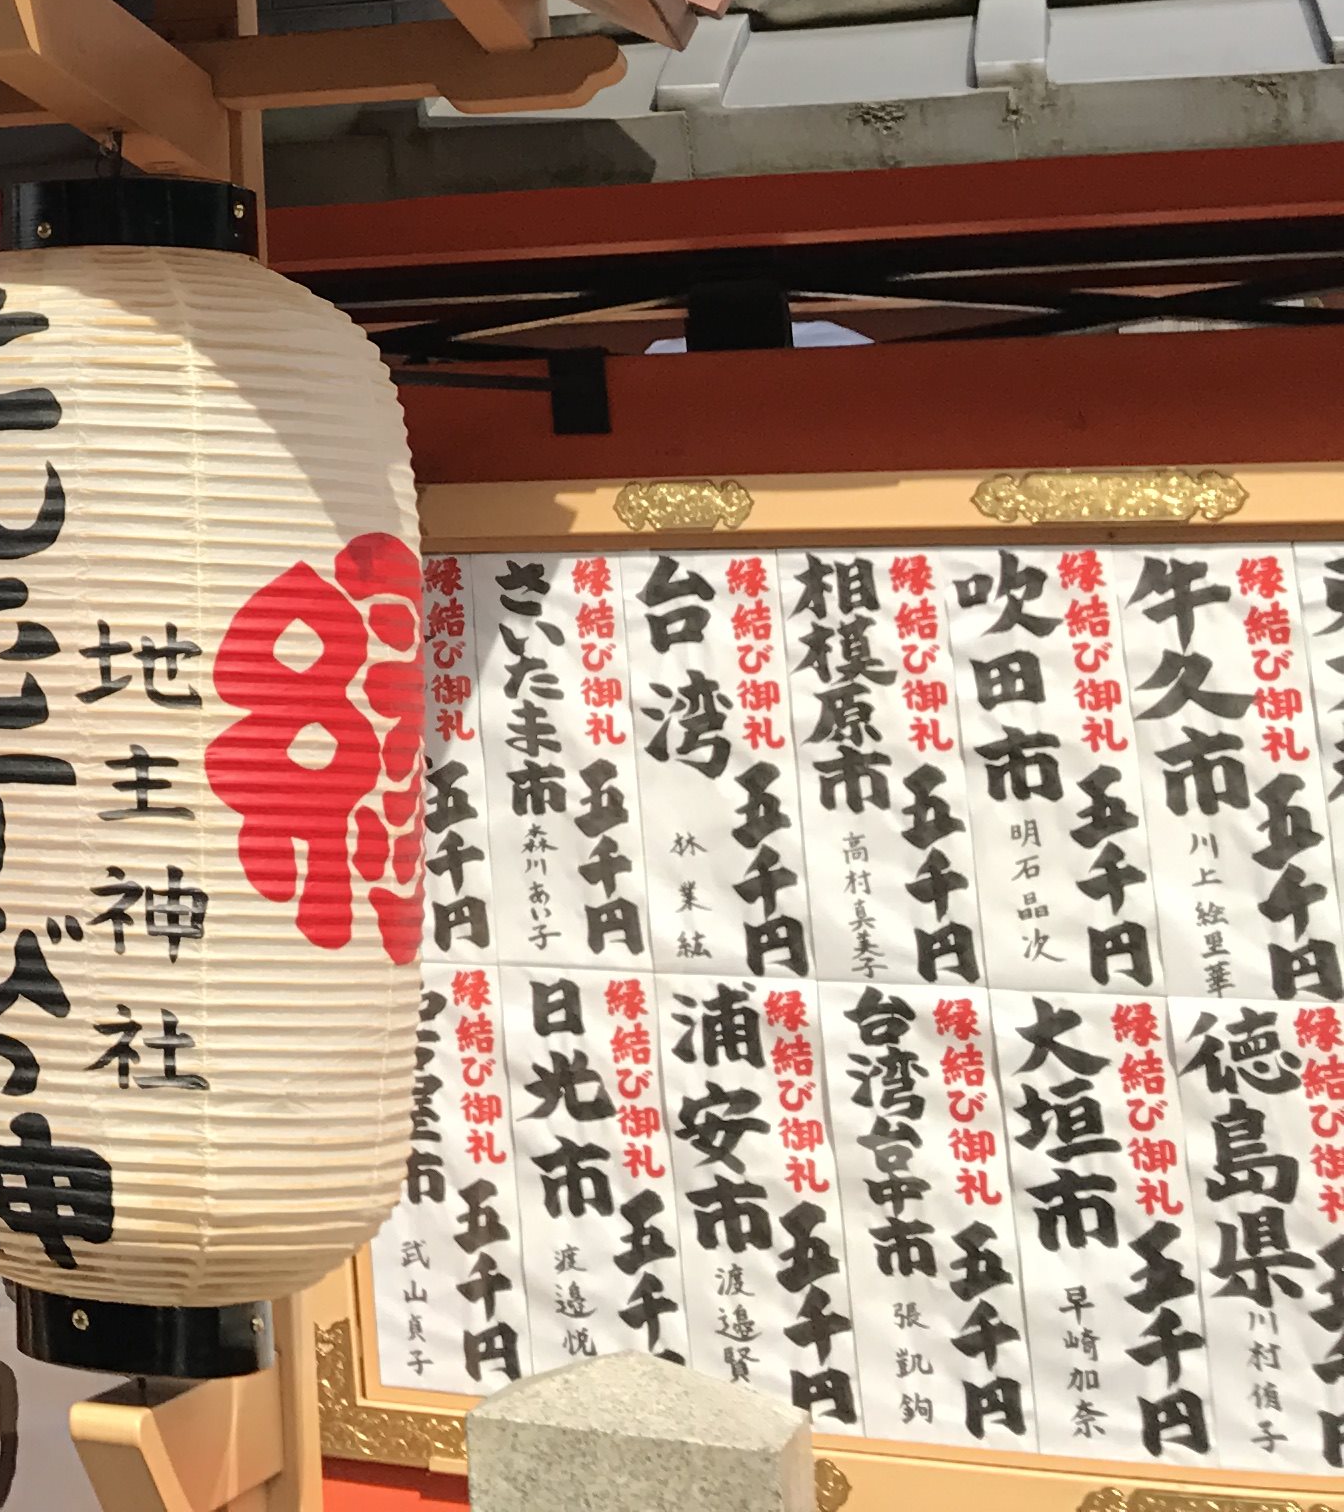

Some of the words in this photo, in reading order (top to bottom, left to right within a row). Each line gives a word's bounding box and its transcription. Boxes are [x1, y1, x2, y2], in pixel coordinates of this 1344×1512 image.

[423, 557, 475, 743] 縁結び御礼
[494, 560, 567, 816] さいたま市
[572, 556, 626, 745] 縁結び御礼
[637, 555, 734, 780] 台湾
[726, 557, 785, 750] 縁結び御礼
[789, 552, 897, 814] 相模原市
[889, 554, 954, 754] 縁結び御礼
[952, 549, 1064, 803] 吹田市
[1010, 819, 1067, 962] 明石晶次
[1057, 549, 1128, 753] 縁結び御礼
[1125, 556, 1254, 817] 牛久市
[1236, 555, 1310, 764] 縁結び御礼
[78, 620, 211, 1091] 地主神社
[425, 759, 490, 952] 五千円
[521, 823, 561, 951] 森川あい子
[574, 758, 645, 956] 五千円
[732, 760, 810, 978] 五千円
[901, 763, 980, 984] 五千円
[1069, 764, 1153, 987] 五千円
[1252, 773, 1344, 1001] 五千円
[452, 970, 507, 1164] 縁結び御礼
[516, 978, 614, 1218] 日光市
[604, 978, 666, 1178] 縁結び御礼
[672, 981, 773, 1253] 浦安市
[764, 990, 831, 1193] 縁結び御礼
[844, 985, 937, 1277] 台湾台中市
[933, 998, 1002, 1206] 縁結び御礼
[1012, 996, 1122, 1251] 大垣市
[1111, 1002, 1183, 1215] 縁結び御礼
[1179, 1007, 1316, 1307] 徳島県
[453, 1179, 522, 1382] 五千円
[614, 1188, 686, 1366] 五千
[776, 1201, 859, 1424] 五千円
[949, 1221, 1027, 1438] 五千円
[1059, 1285, 1108, 1438] 早崎加奈
[1125, 1220, 1210, 1457] 五千円
